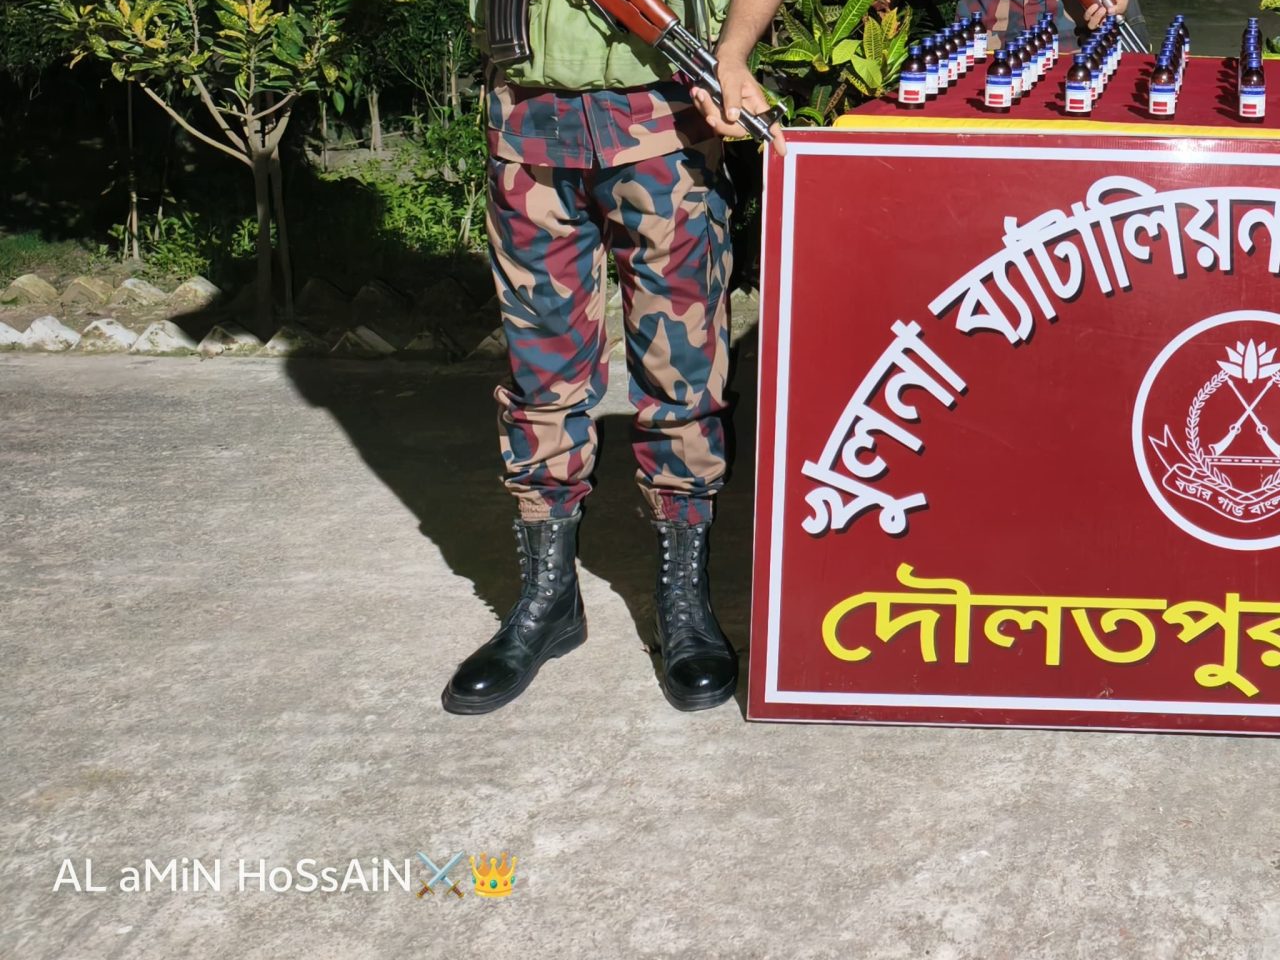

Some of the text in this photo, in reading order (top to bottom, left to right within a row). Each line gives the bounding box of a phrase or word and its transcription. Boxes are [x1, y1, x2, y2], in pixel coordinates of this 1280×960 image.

[801, 319, 967, 535] খুলনা
[1175, 477, 1213, 501] বর্ডার
[1218, 495, 1246, 517] গার্ড
